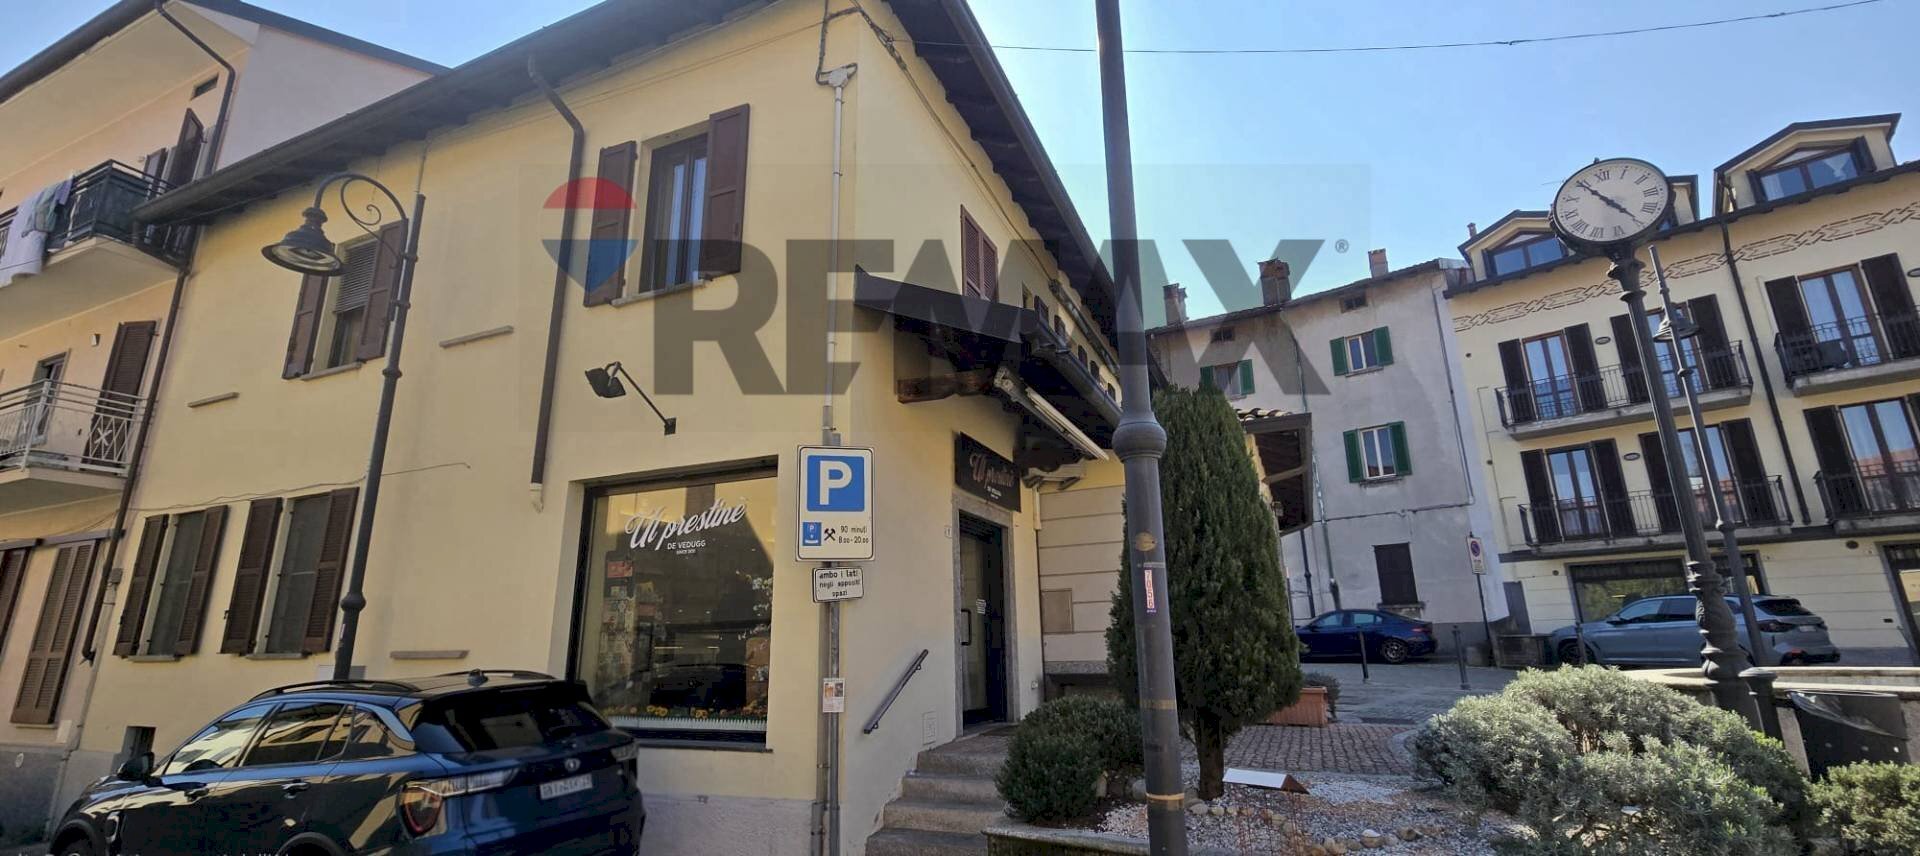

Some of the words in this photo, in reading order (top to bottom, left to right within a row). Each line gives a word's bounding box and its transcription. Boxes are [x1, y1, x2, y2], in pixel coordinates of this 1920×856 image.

[820, 461, 852, 505] P
[840, 525, 849, 534] 90
[851, 525, 868, 534] minuti
[667, 542, 677, 550] DE
[678, 540, 706, 549] VEDUGG
[819, 570, 838, 579] ambo
